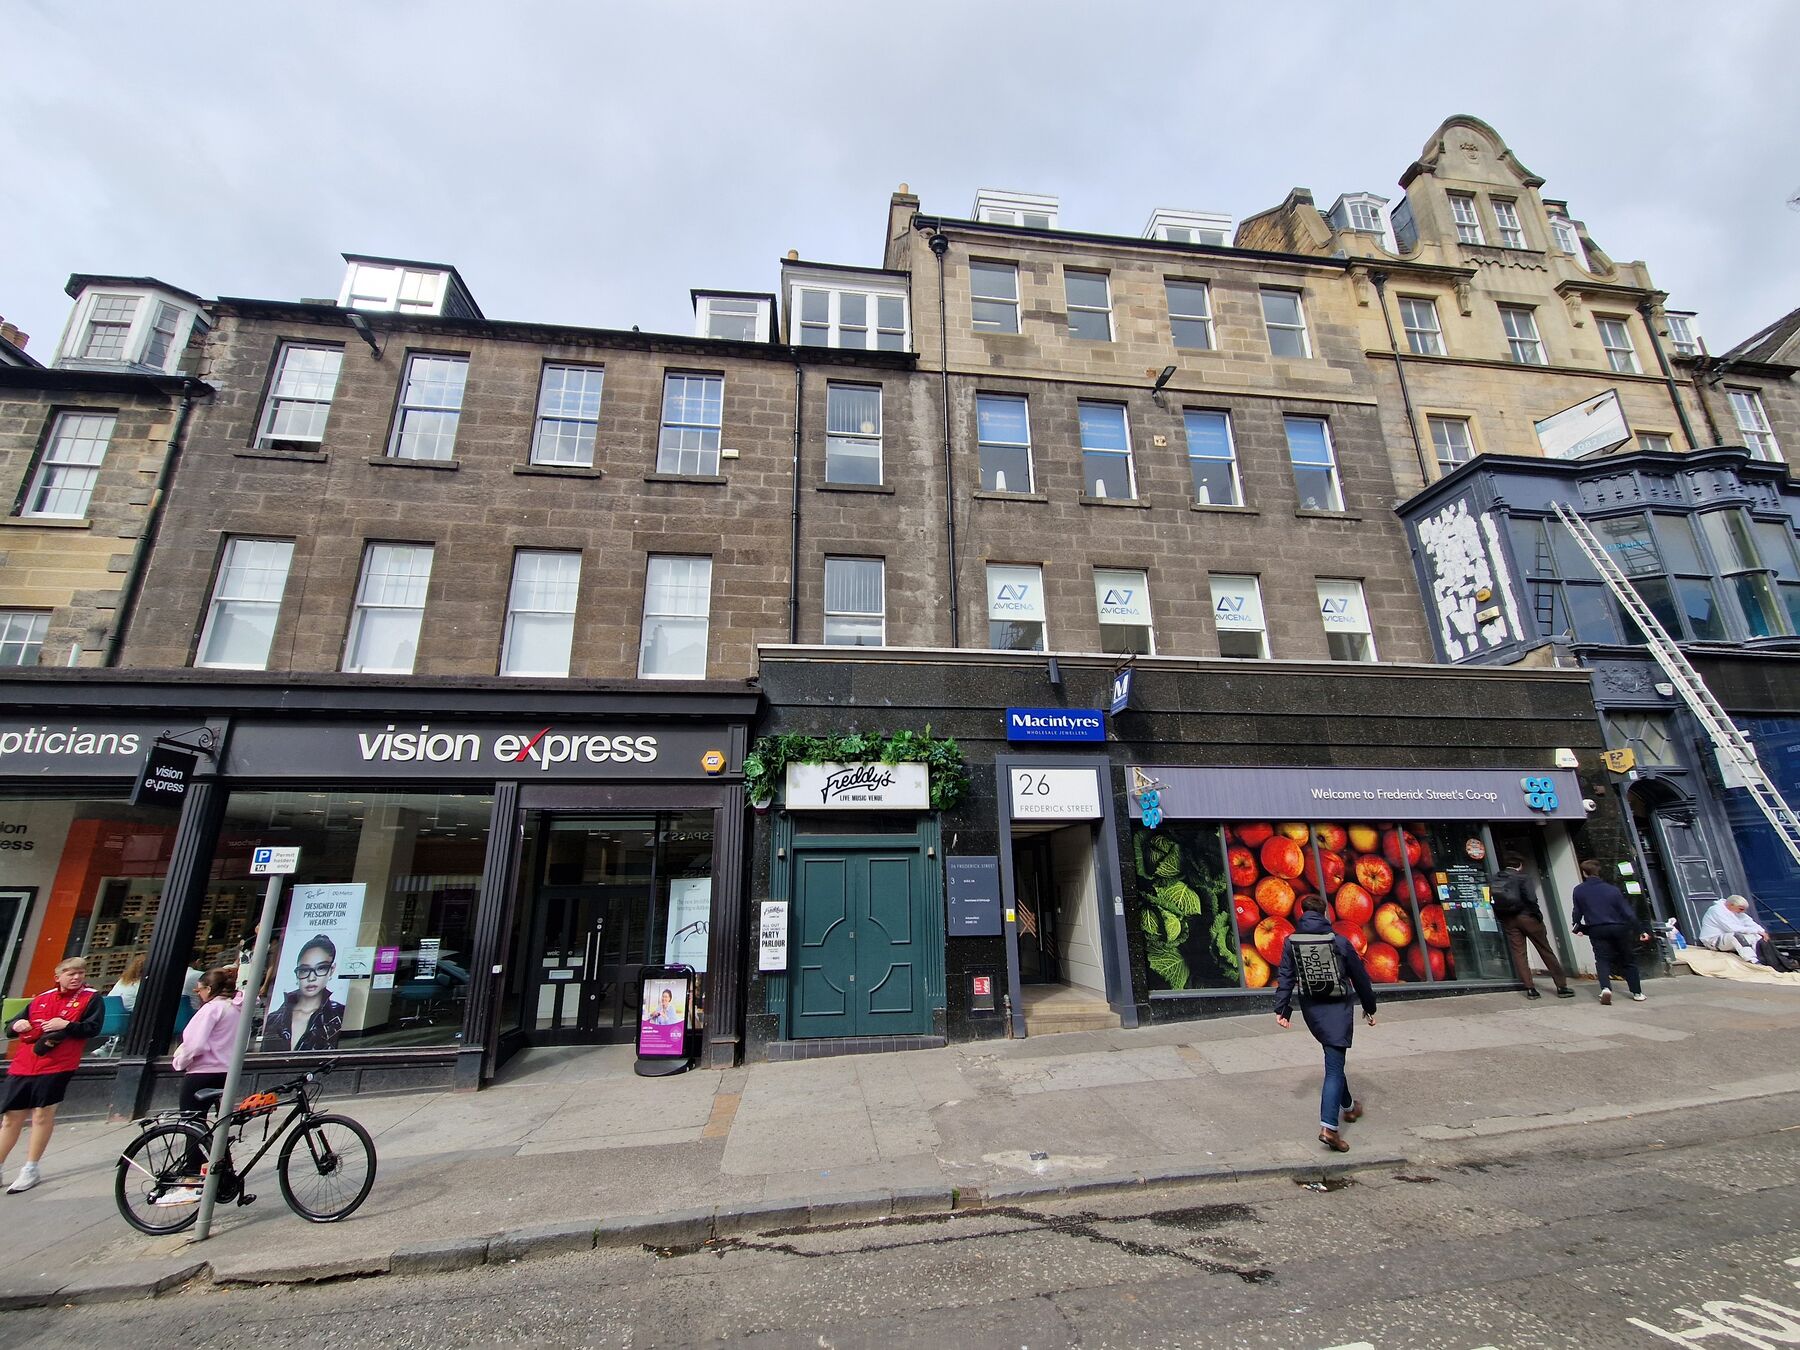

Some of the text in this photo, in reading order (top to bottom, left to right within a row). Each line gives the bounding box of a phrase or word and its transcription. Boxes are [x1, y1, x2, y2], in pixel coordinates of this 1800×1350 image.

[993, 602, 1034, 610] AVICENA
[1100, 607, 1140, 615] AVICENA
[1012, 714, 1099, 729] Macintyres
[0, 726, 140, 755] pticians
[358, 724, 658, 771] vision express
[155, 765, 184, 780] vision
[144, 777, 185, 793] express
[820, 766, 896, 804] Freddy's
[1019, 773, 1050, 796] 26
[839, 794, 883, 802] LIVE MUSIC VENUE
[1310, 787, 1498, 803] Welcome to Frederick Street's Co-op
[1020, 804, 1094, 813] FREDERICK STREET
[0, 821, 28, 835] ion
[0, 840, 34, 851] ess
[259, 850, 270, 862] P
[950, 877, 956, 885] 3
[305, 902, 348, 910] DESIGNED FOR
[951, 896, 956, 904] 2
[303, 910, 346, 918] PRESCRIPTION
[308, 918, 338, 926] WEARERS
[761, 931, 780, 939] PARTY
[761, 939, 786, 947] PARLOUR
[1302, 955, 1317, 981] FACE
[1309, 945, 1324, 981] NORTH
[1321, 960, 1334, 981] THE
